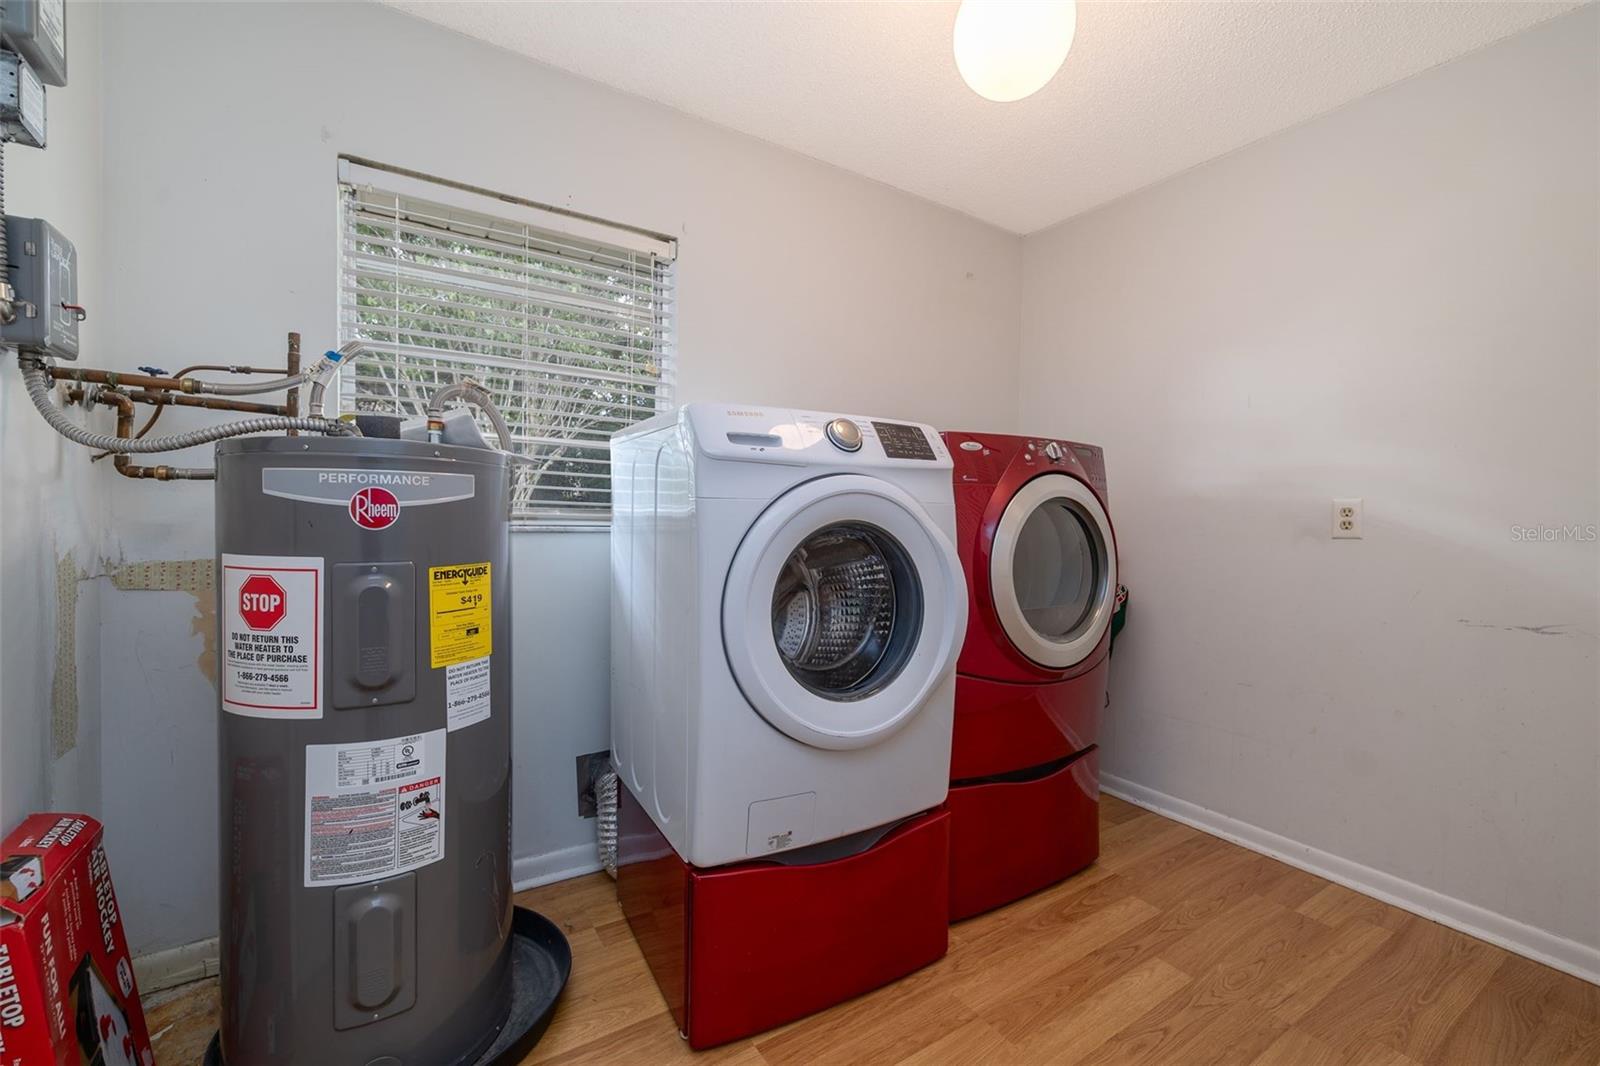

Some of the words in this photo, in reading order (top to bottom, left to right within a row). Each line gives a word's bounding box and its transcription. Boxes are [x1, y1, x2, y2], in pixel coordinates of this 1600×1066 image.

[319, 472, 430, 486] PERFORMANCE
[355, 487, 397, 523] Rheem
[242, 593, 281, 612] STOP
[232, 632, 239, 641] DO
[239, 633, 250, 642] NOT
[251, 634, 279, 644] RETURN
[281, 635, 299, 644] THIS
[234, 642, 253, 652] WATER
[254, 643, 282, 653] HEATER
[283, 645, 294, 653] TO
[227, 649, 236, 659] THE
[236, 651, 255, 661] PLACE
[255, 653, 265, 661] OF
[266, 654, 308, 663] PURCHASE
[237, 671, 289, 682] 1-866-279-4566
[409, 779, 440, 791] DANGER
[36, 825, 64, 849] HOCKEY
[59, 819, 87, 846] TABLETOP
[92, 849, 101, 881] AIR
[97, 843, 117, 924] TABLETOP
[96, 881, 115, 954] HOCKEY
[41, 912, 53, 956] FUN
[48, 957, 59, 998] FOR
